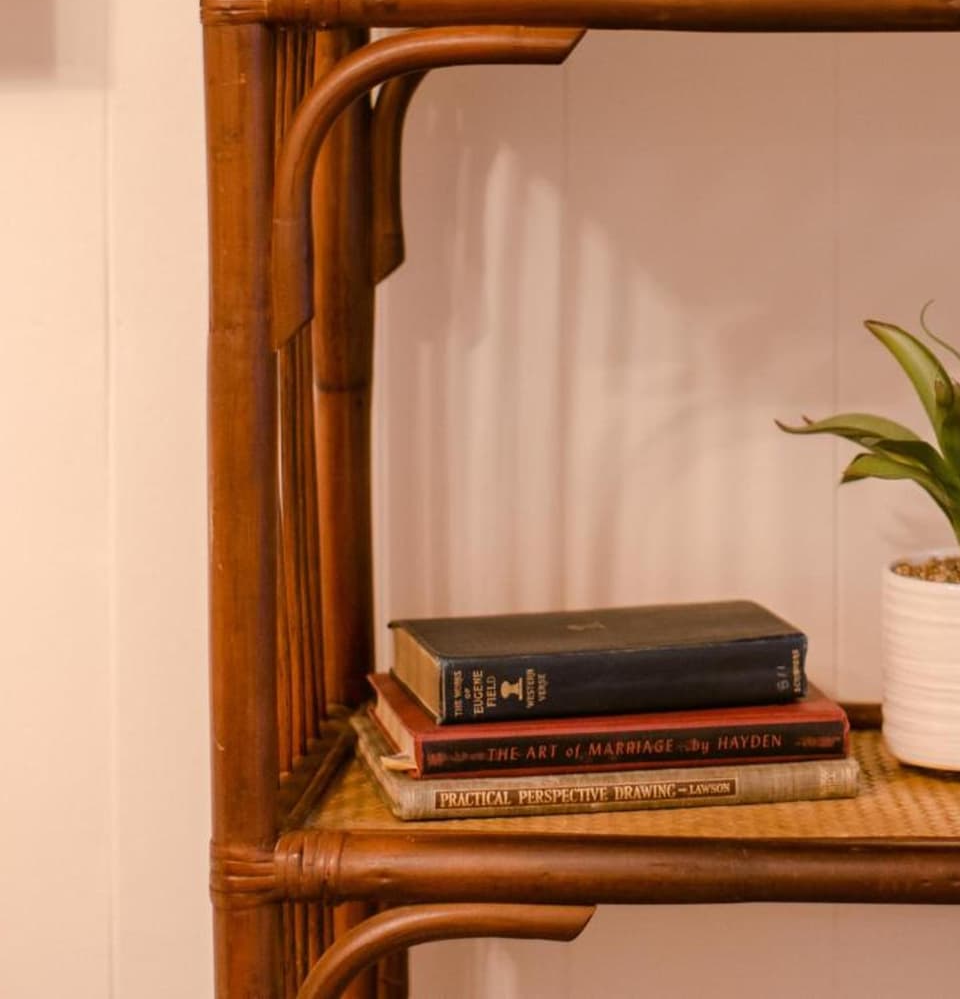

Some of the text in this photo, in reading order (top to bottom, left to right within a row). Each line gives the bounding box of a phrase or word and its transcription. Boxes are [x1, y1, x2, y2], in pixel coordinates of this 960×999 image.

[472, 669, 485, 714] EUGENE
[486, 675, 497, 707] FIELD
[487, 747, 518, 761] THE
[526, 745, 558, 760] ART
[565, 744, 581, 760] of
[588, 738, 674, 757] MARRIAGE
[692, 740, 710, 753] by
[717, 734, 783, 751] HAYDEN
[439, 783, 731, 807] PRACTICAL PERSPECTIVE DRAWING LAWSON
